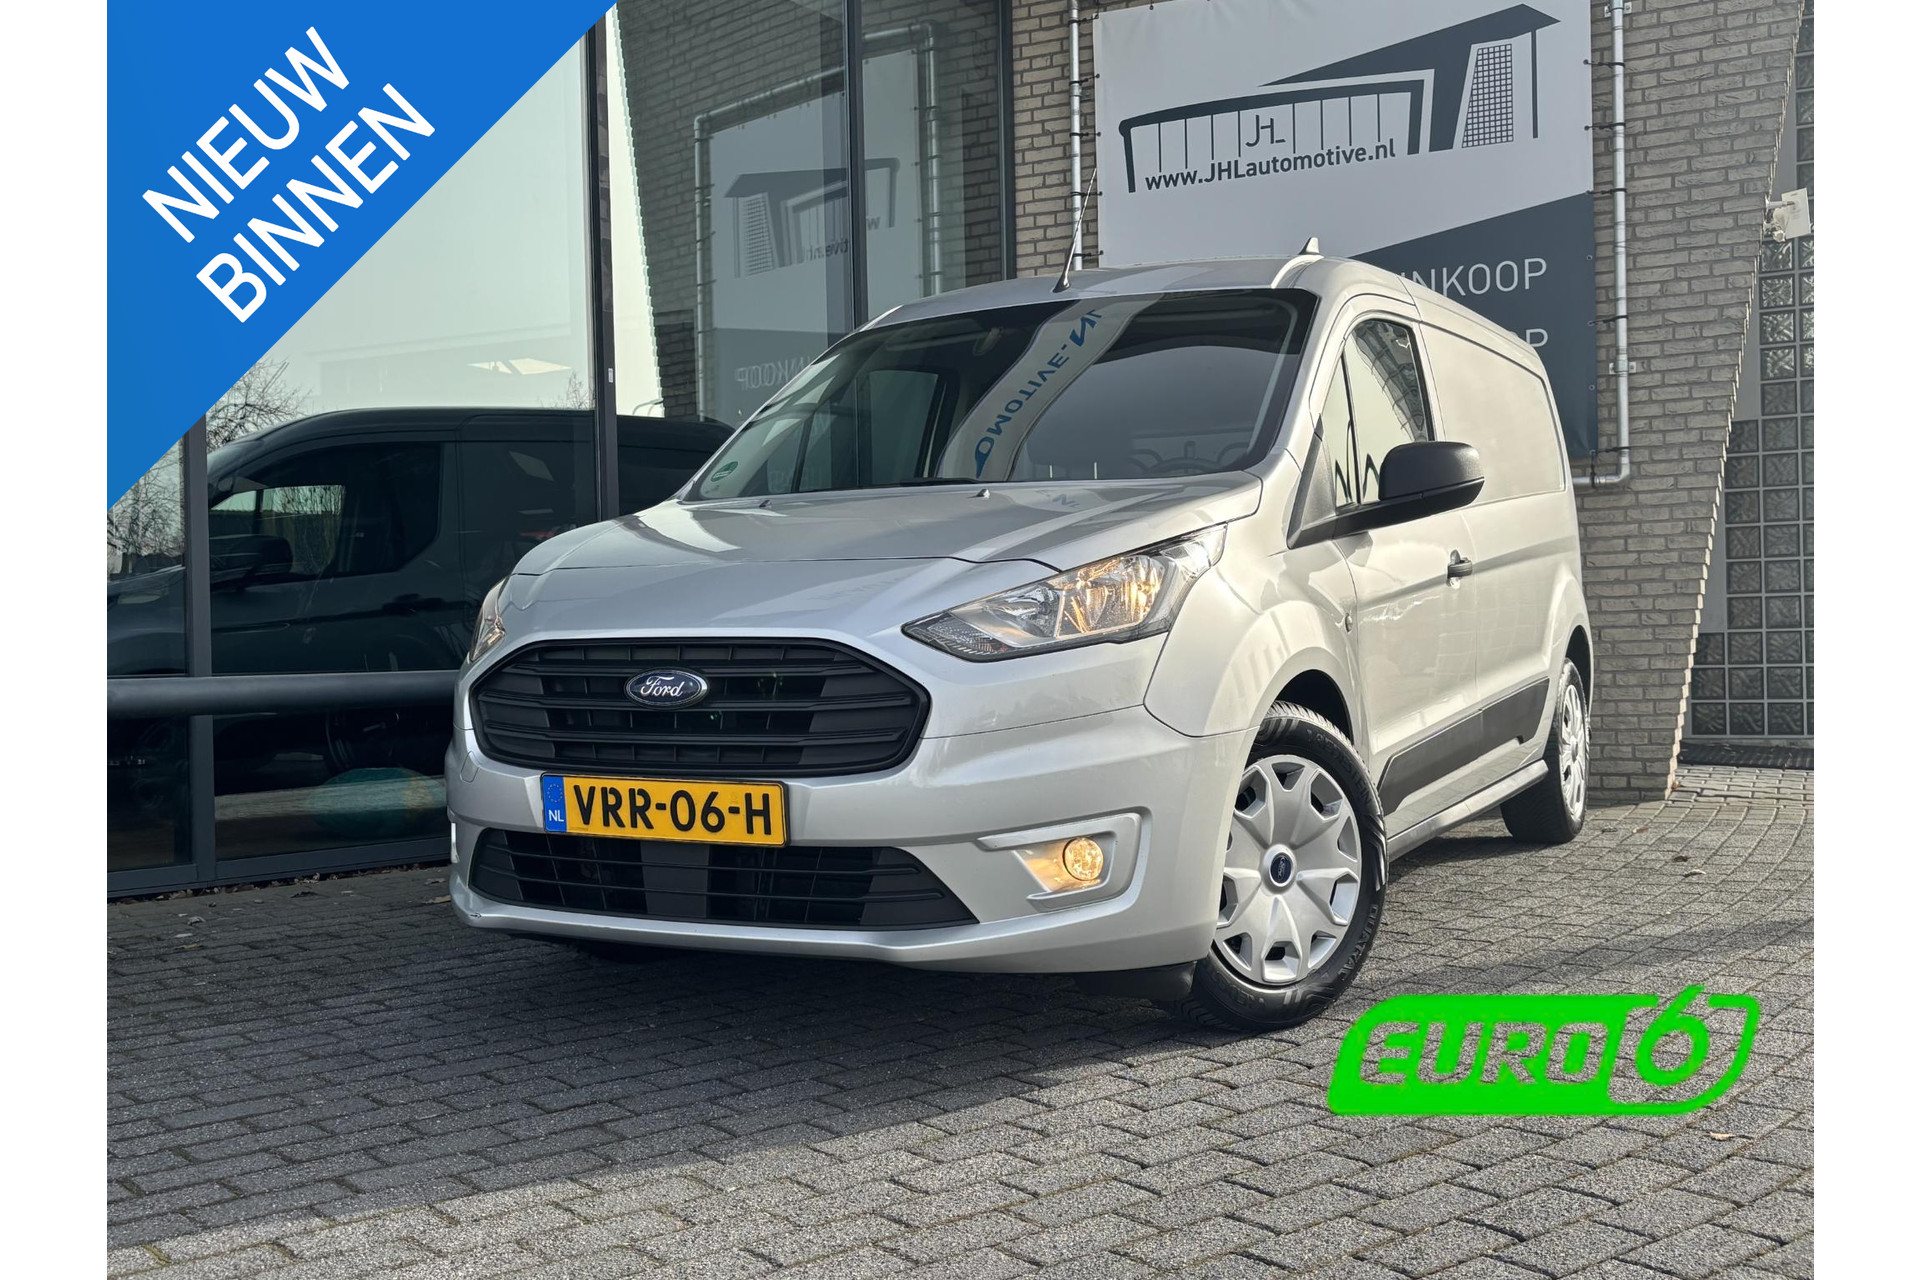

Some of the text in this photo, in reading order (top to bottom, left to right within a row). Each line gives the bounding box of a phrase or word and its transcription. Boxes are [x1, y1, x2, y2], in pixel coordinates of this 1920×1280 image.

[1144, 137, 1397, 191] www.JHLautomotive.nl
[1400, 257, 1547, 297] NKOOP
[640, 675, 686, 697] Ford
[548, 784, 772, 836] NL VRR-06-H
